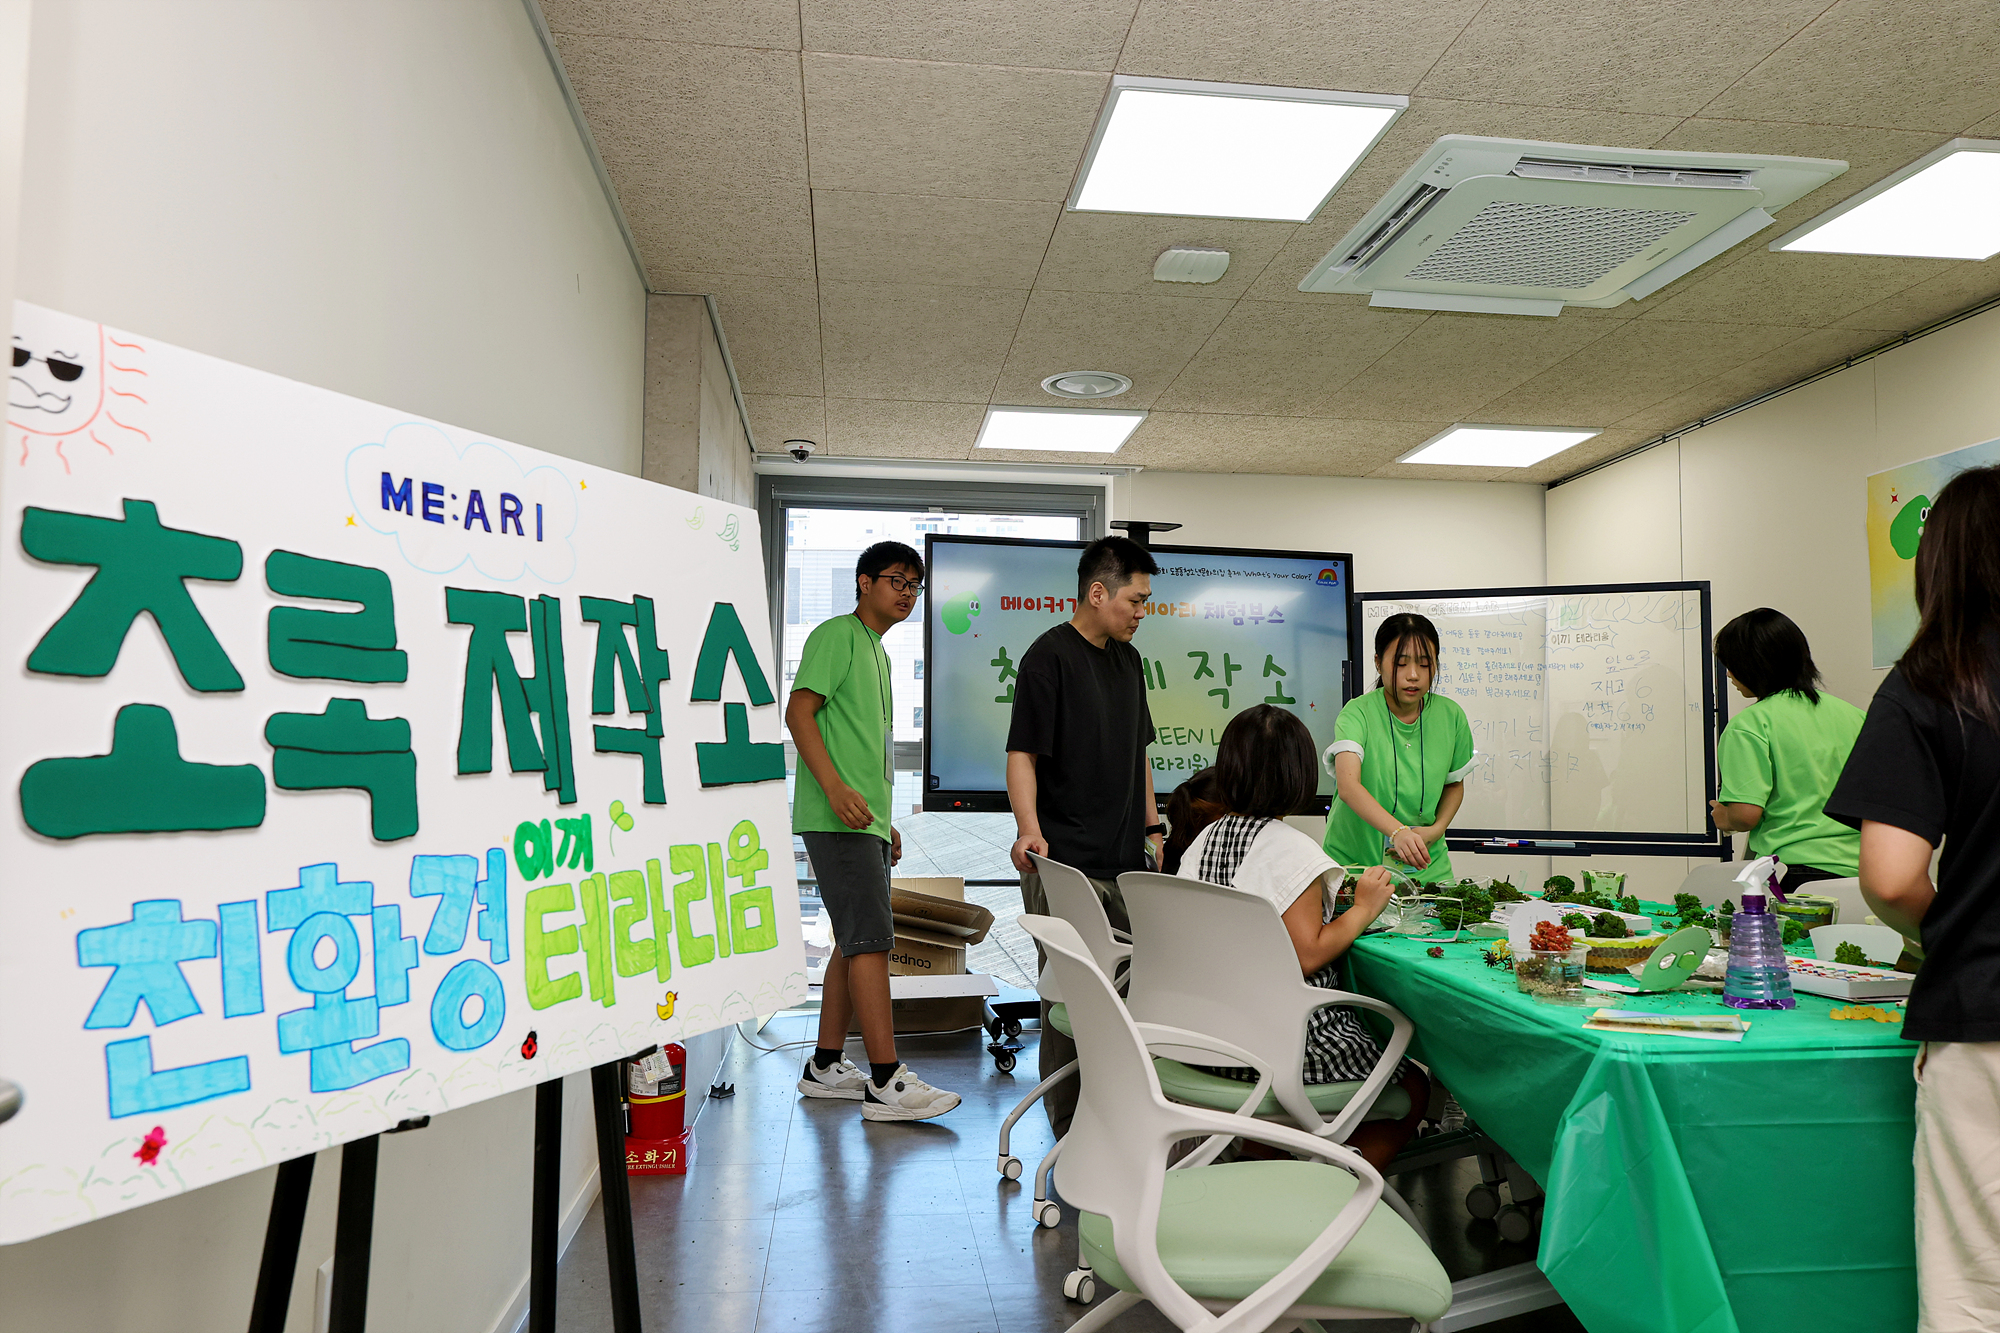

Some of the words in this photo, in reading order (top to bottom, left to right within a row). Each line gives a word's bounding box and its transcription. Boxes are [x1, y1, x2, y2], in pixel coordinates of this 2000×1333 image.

[380, 471, 545, 543] ME:ARI
[20, 498, 419, 842] 초록
[445, 585, 787, 805] 제작소
[1634, 676, 1653, 699] 6
[524, 820, 779, 1011] 테라리움
[76, 847, 510, 1119] 친환경
[889, 953, 932, 969] coupa
[625, 1148, 677, 1164] 소화기
